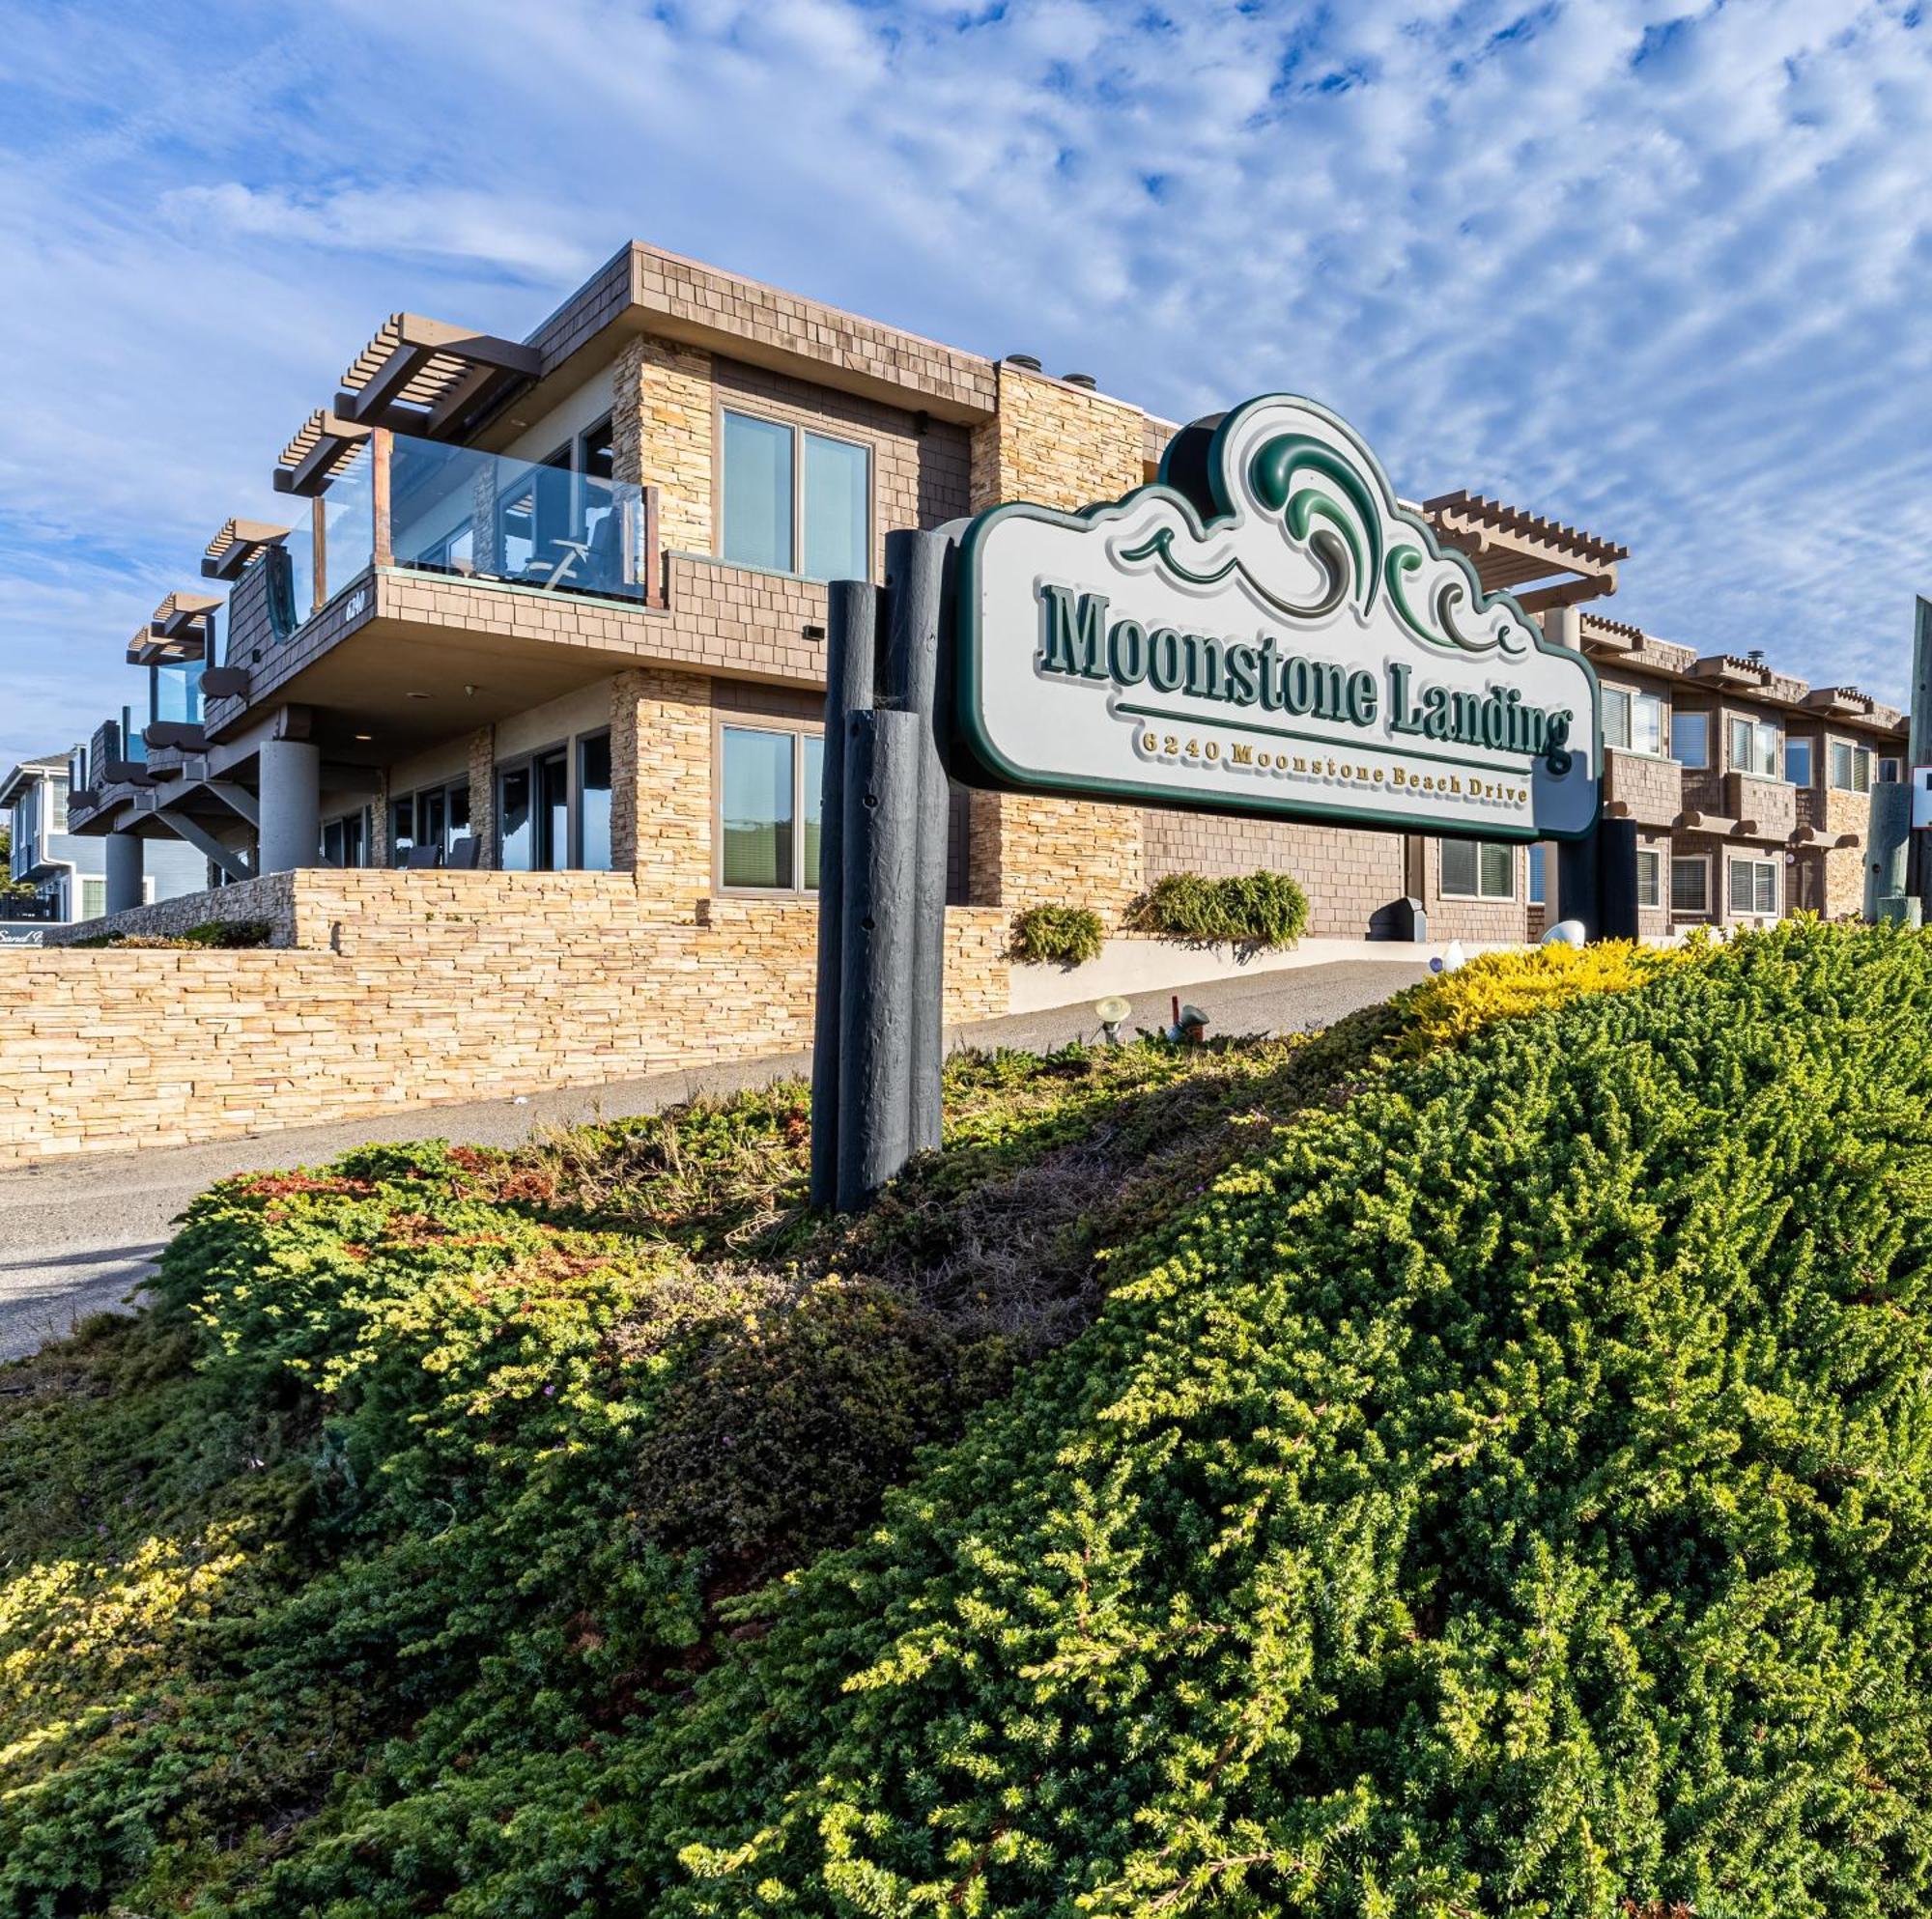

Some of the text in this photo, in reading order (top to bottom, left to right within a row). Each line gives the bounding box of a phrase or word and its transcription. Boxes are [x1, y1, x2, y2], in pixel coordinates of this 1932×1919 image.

[346, 589, 365, 621] 6240
[1040, 584, 1574, 776] Moonstone Landing
[1143, 732, 1528, 803] 6240 Moonstone Beach Drive
